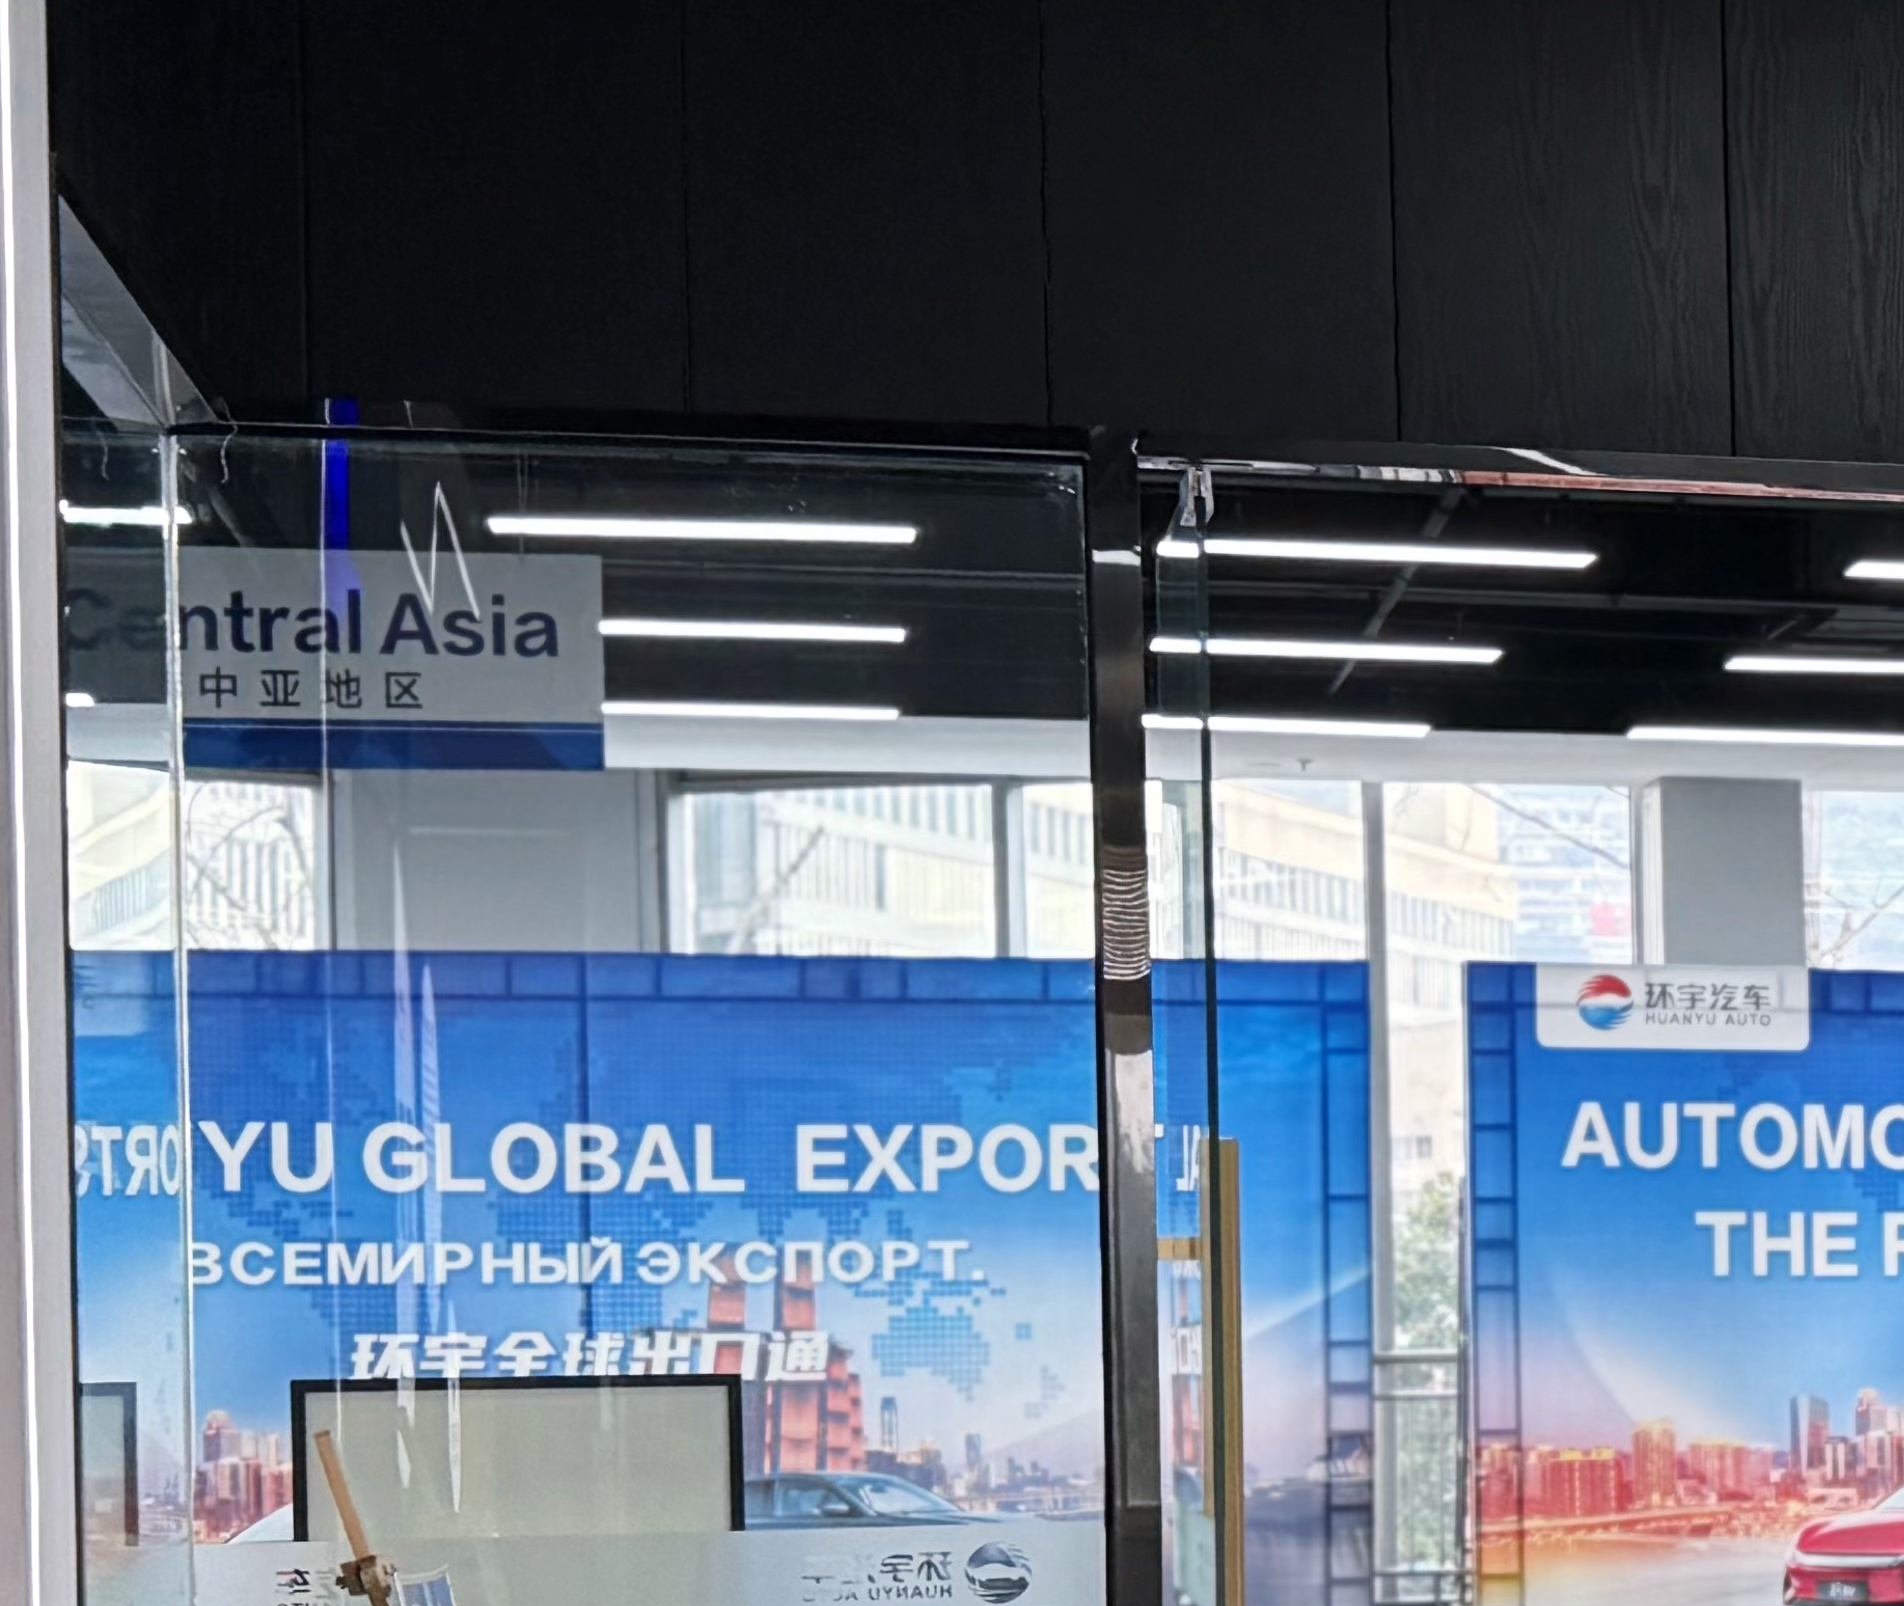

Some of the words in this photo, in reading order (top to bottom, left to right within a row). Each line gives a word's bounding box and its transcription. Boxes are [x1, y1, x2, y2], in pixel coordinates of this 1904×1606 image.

[381, 592, 559, 657] Asia
[200, 666, 423, 710] 中亚地区
[1645, 983, 1771, 1010] 环宇汽车
[1645, 1013, 1716, 1026] HUANYU
[1725, 1013, 1771, 1026] AUTO
[198, 1121, 334, 1193] YU
[362, 1122, 745, 1194] GLOBAL
[797, 1124, 1163, 1193] EXPOR
[1695, 1211, 1859, 1278] THE
[351, 1332, 829, 1381] 环宇全球出口通
